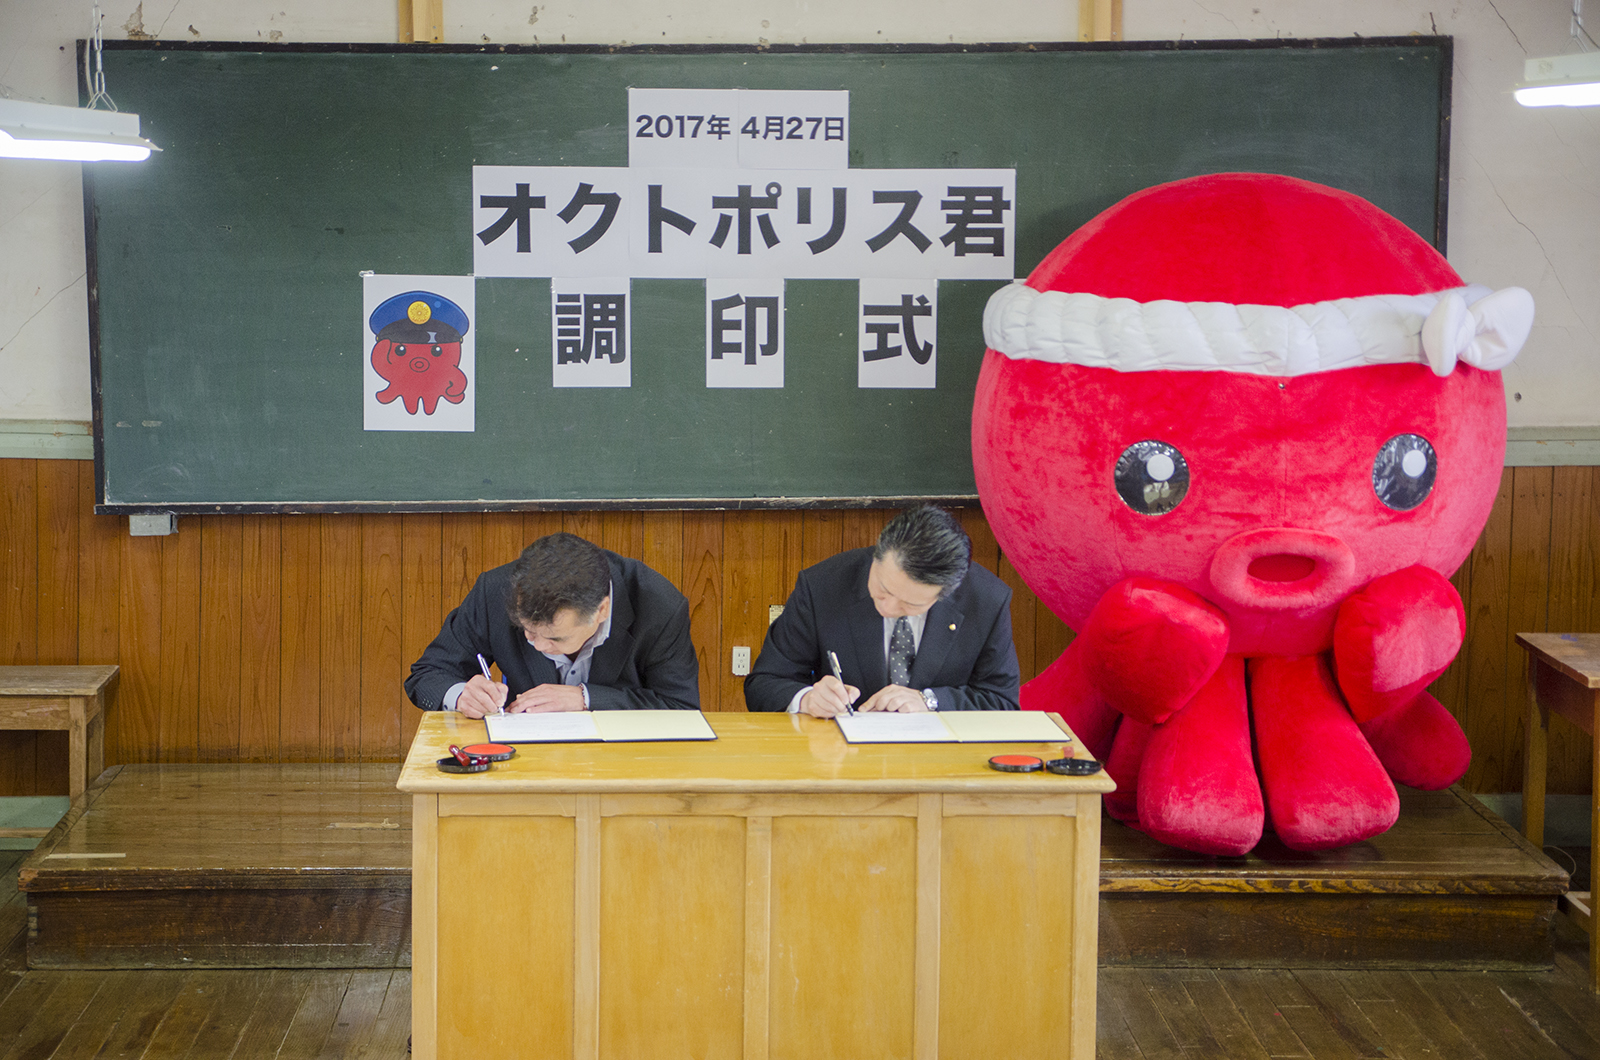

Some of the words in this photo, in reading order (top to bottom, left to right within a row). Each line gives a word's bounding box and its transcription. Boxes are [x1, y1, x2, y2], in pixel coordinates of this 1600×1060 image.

[636, 115, 731, 141] 2017年
[741, 117, 844, 142] 4月27日
[477, 181, 1011, 257] オクトポリス君
[556, 293, 626, 365] 調
[711, 293, 779, 366] 印
[863, 294, 933, 366] 式
